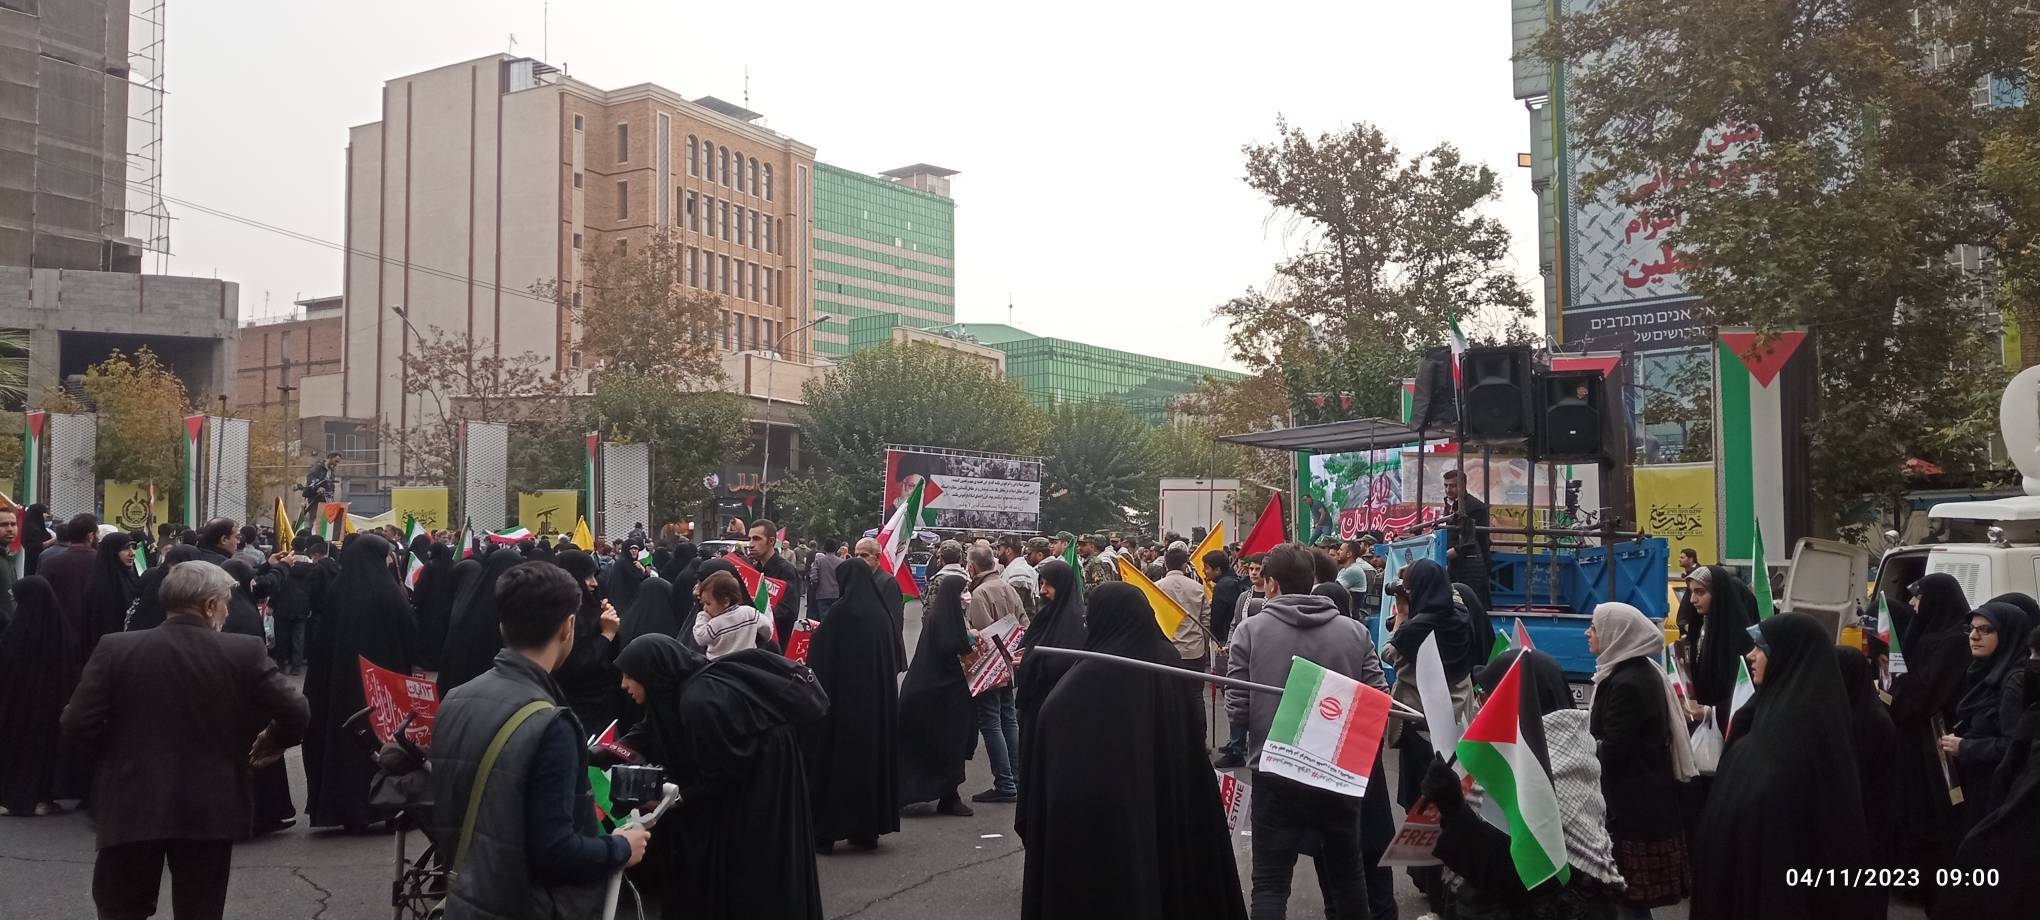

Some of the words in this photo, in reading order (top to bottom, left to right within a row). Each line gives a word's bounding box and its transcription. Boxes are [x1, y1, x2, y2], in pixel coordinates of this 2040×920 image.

[1590, 313, 1655, 330] מתנדבים
[1228, 783, 1245, 832] ESTINE
[1394, 827, 1440, 847] FREE
